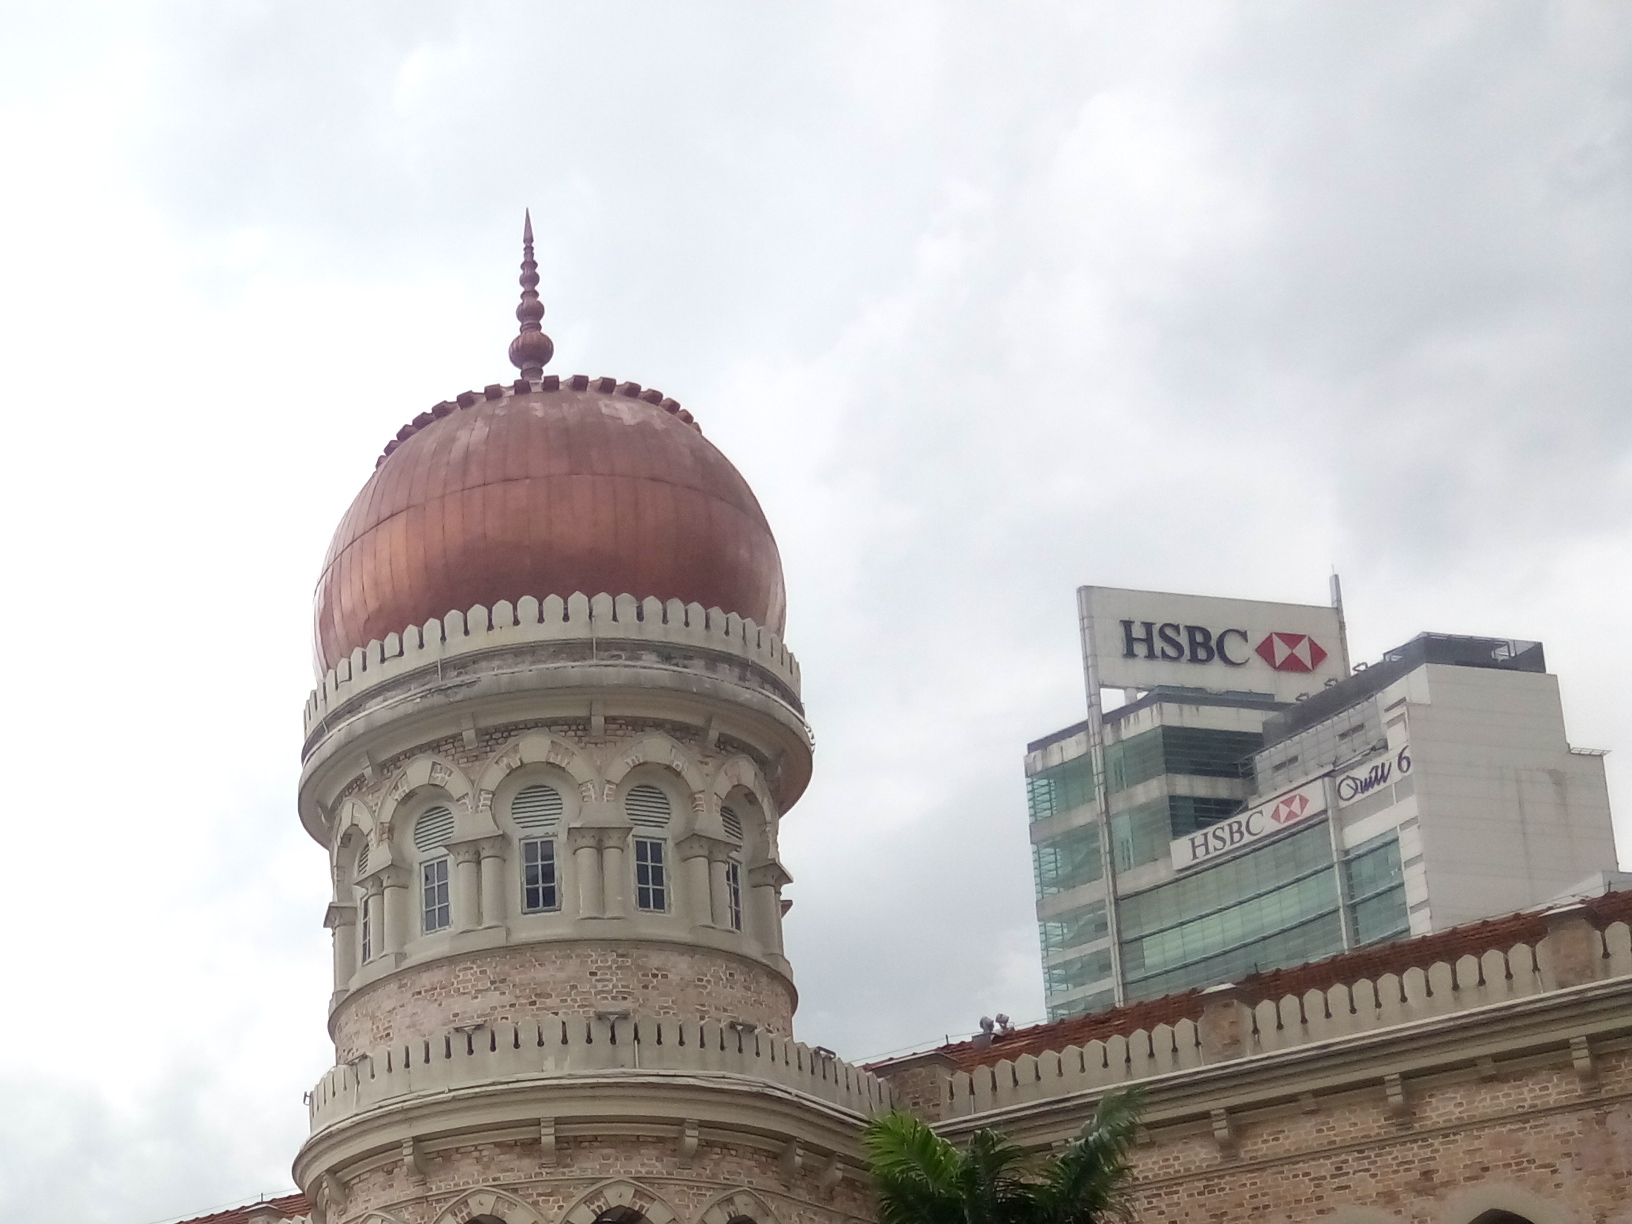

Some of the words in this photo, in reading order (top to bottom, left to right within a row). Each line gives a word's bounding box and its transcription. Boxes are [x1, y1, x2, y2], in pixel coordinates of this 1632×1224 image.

[1119, 619, 1250, 666] HSBC
[1337, 761, 1392, 801] Quill
[1397, 745, 1411, 773] 6
[1188, 810, 1265, 861] HSBC
